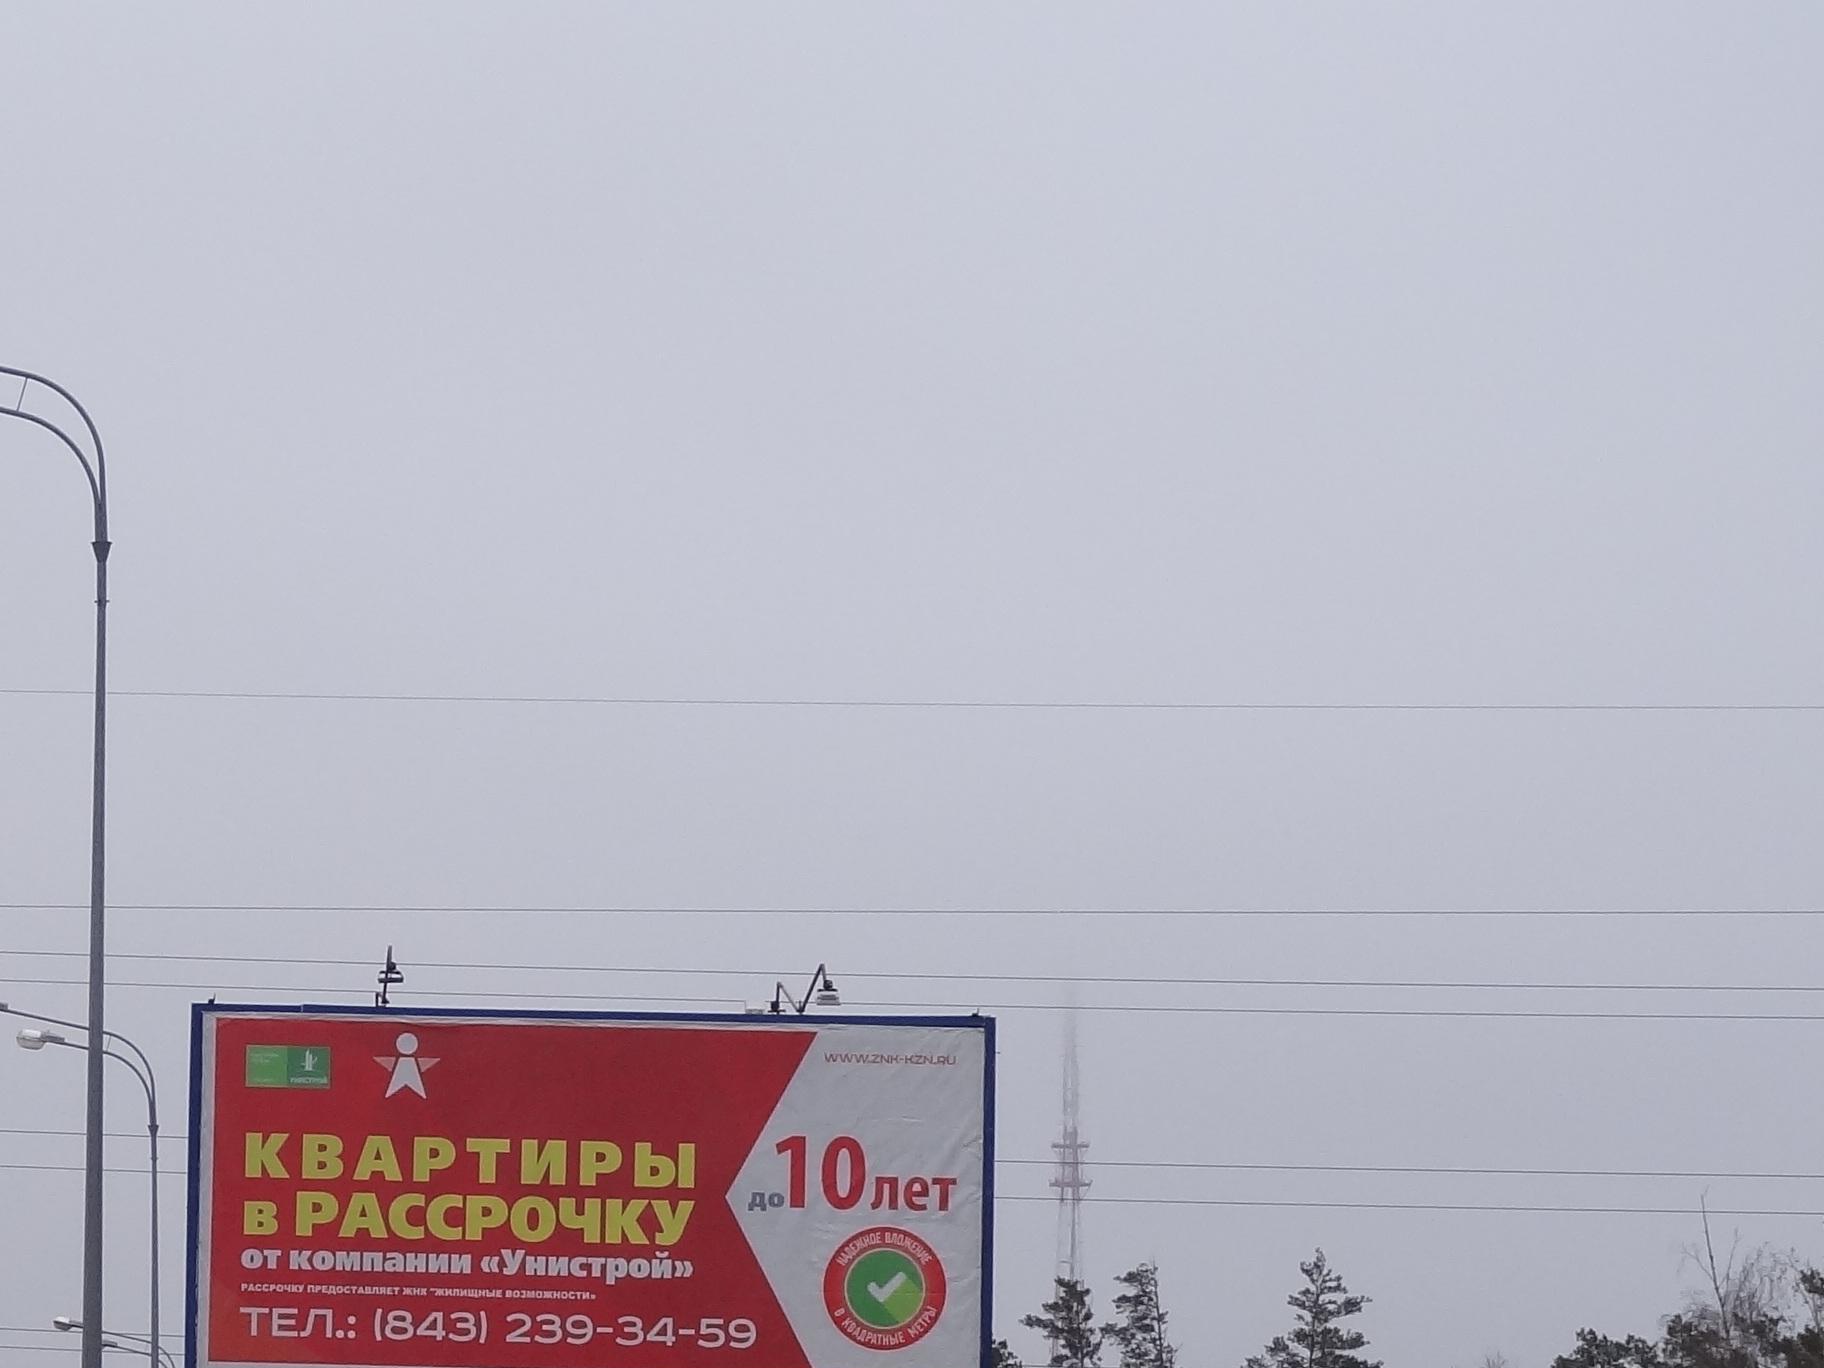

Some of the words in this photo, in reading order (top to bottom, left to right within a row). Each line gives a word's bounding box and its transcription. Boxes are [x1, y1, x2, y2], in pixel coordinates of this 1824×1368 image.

[244, 1131, 696, 1189] КВАРТИРЫ
[747, 1191, 785, 1212] до
[775, 1135, 866, 1211] 10
[870, 1175, 958, 1212] лет
[242, 1200, 279, 1236] в
[295, 1190, 695, 1246] РАССРОЧКУ
[240, 1248, 282, 1270] от
[288, 1250, 473, 1275] компании
[479, 1248, 694, 1284] «Унистрой»
[884, 1232, 933, 1266] ВЛОЖЕНИЕ
[240, 1282, 305, 1294] РАССРОЧКУ
[307, 1284, 400, 1296] ПРЕДОСТАВЛЯЕТ
[401, 1286, 427, 1297] ЖНК
[239, 1306, 357, 1338] ТЕЛ.:
[374, 1308, 488, 1344] (843)
[505, 1312, 758, 1350] 239-34-59
[833, 1307, 846, 1318] В
[841, 1317, 906, 1346] КВАДРАТНЫЕ
[907, 1305, 938, 1338] МЕТРЫ
